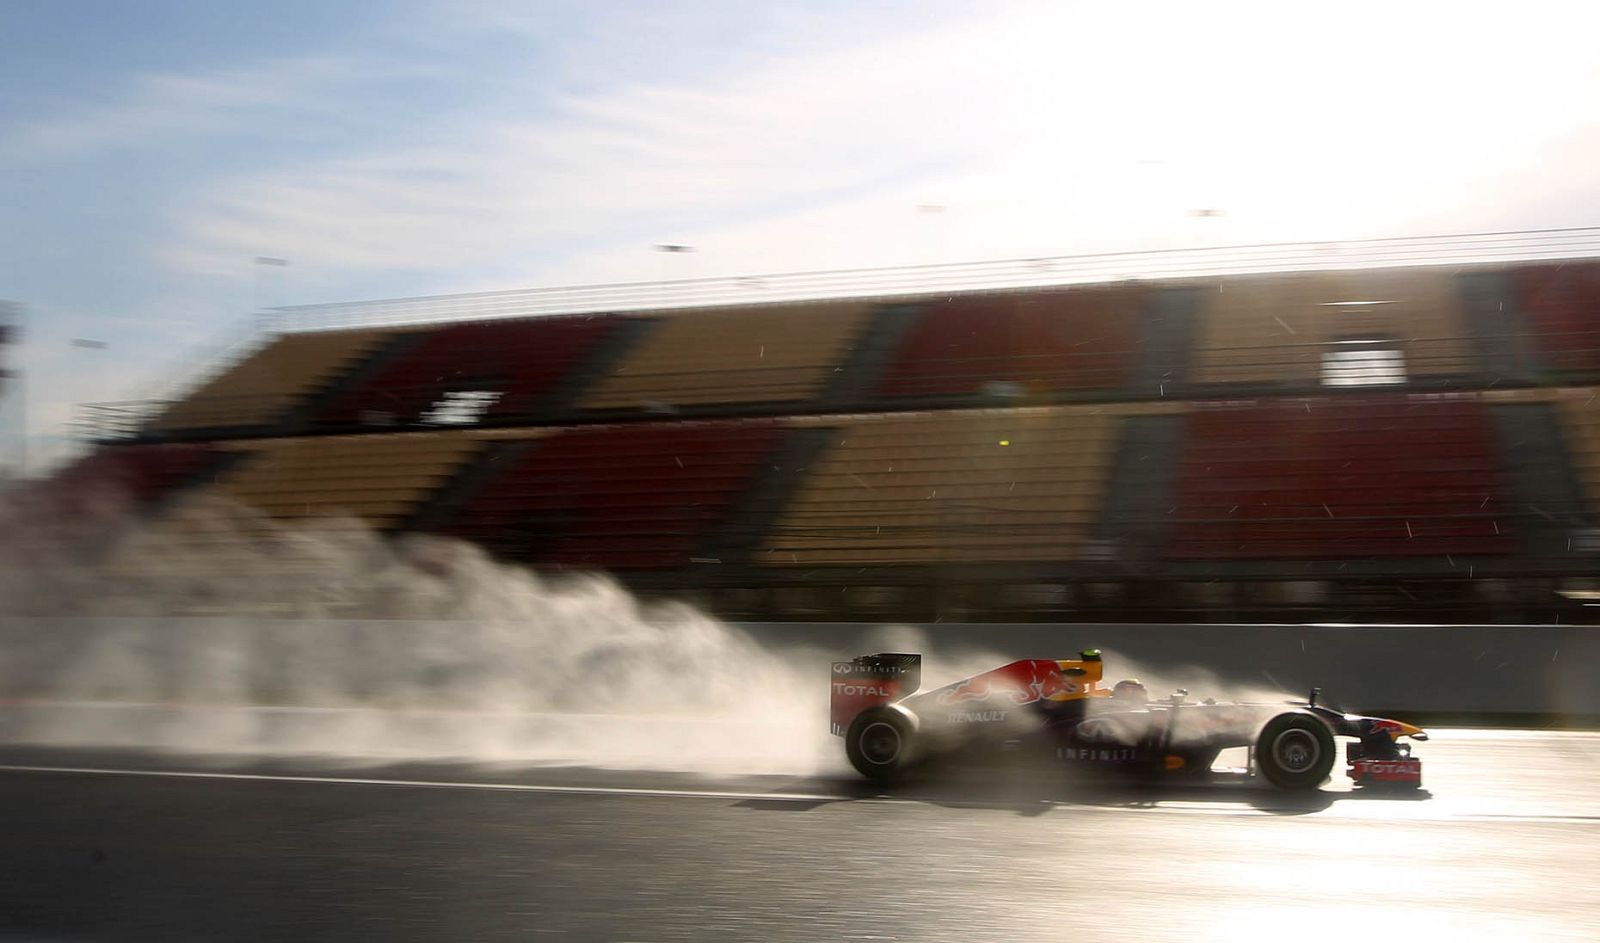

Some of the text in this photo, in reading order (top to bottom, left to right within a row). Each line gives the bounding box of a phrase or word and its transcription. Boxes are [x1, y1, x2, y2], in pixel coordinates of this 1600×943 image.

[833, 682, 889, 696] TOTAL
[947, 711, 1008, 724] RENAULT
[1056, 749, 1136, 761] INFINITI
[1359, 762, 1420, 775] TOTAL
